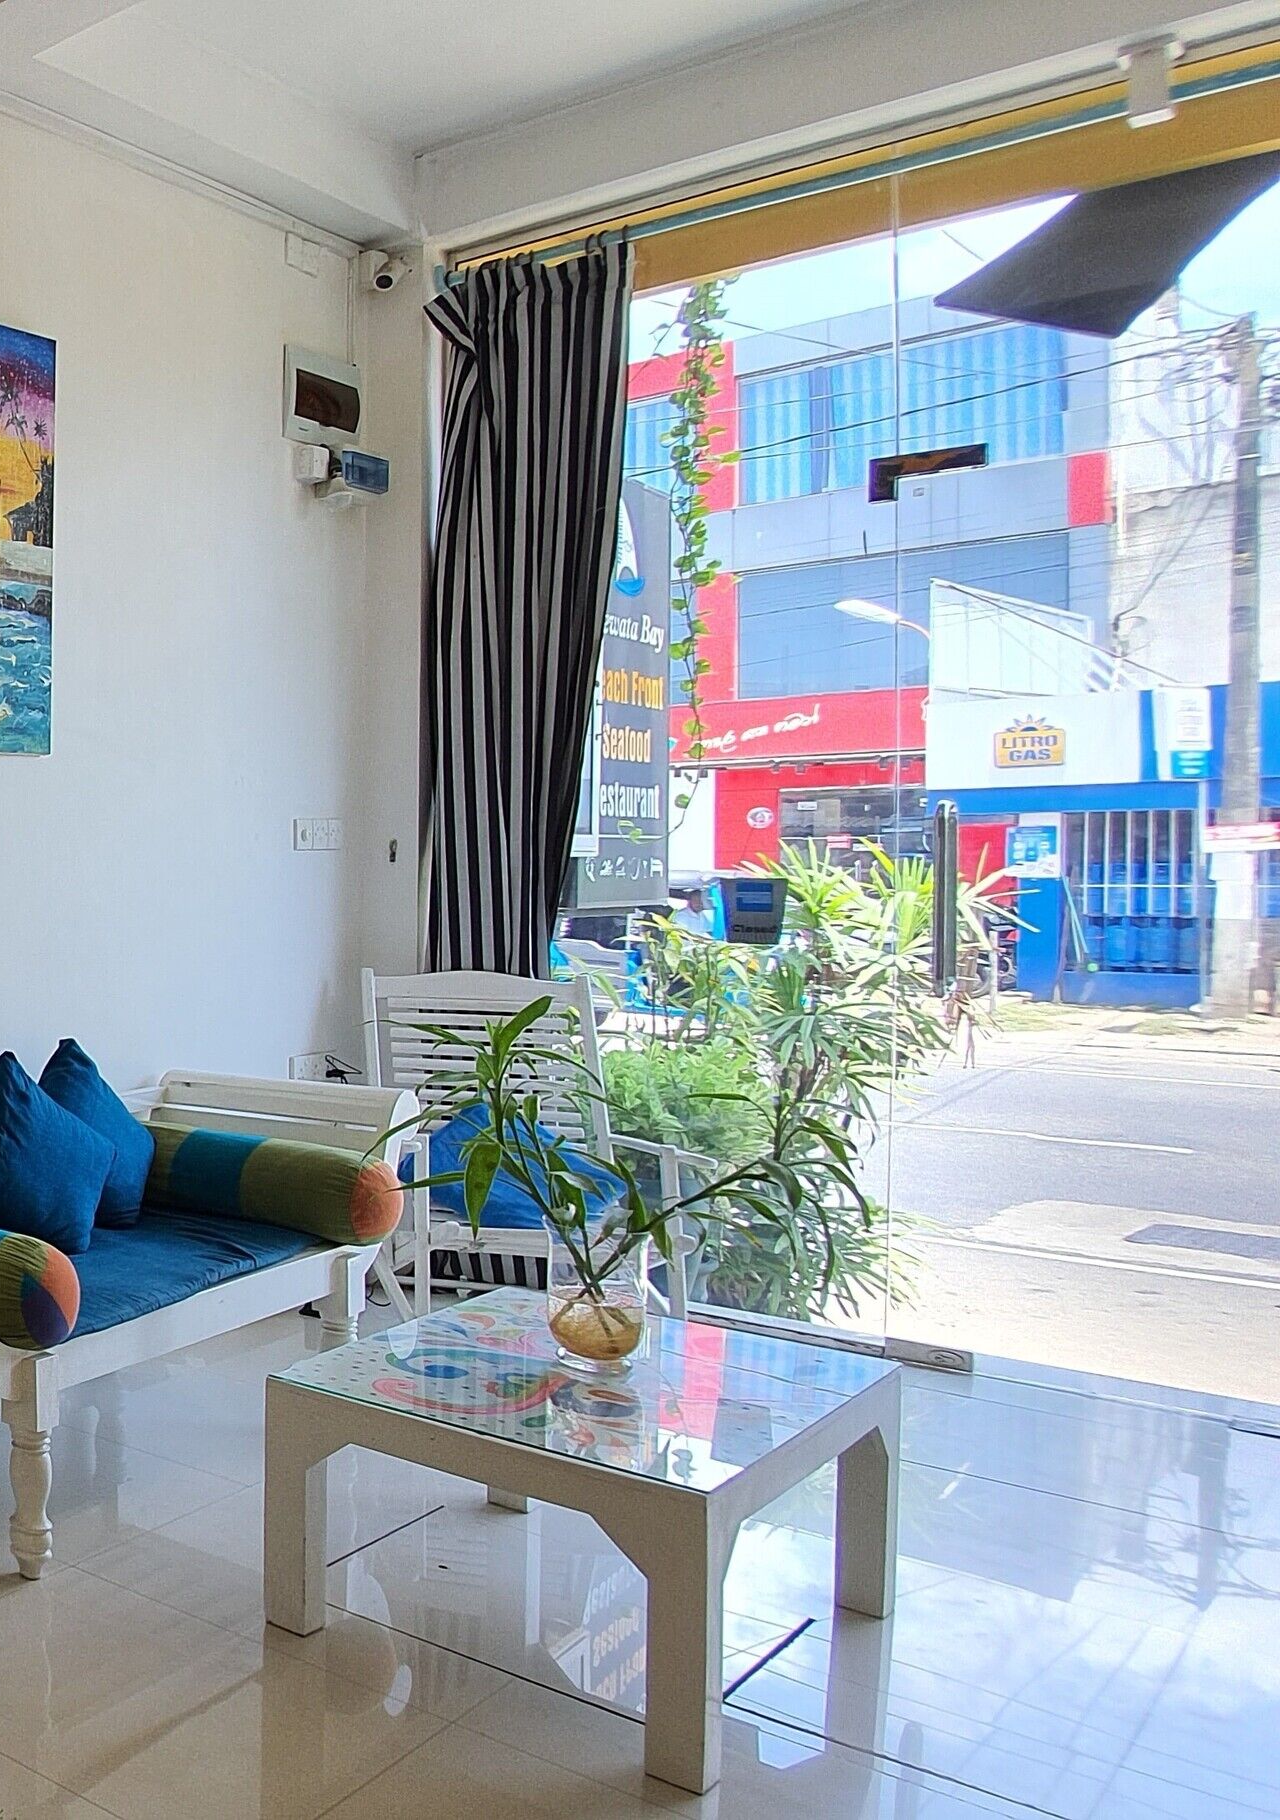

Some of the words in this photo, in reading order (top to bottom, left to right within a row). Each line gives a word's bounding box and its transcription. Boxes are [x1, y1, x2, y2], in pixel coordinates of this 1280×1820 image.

[603, 614, 639, 641] ewata
[640, 614, 665, 653] Bay
[632, 671, 664, 710] Front
[602, 723, 651, 763] Seafood
[1001, 734, 1058, 749] LITRO
[1008, 749, 1052, 762] GAS
[600, 781, 660, 819] estaurant
